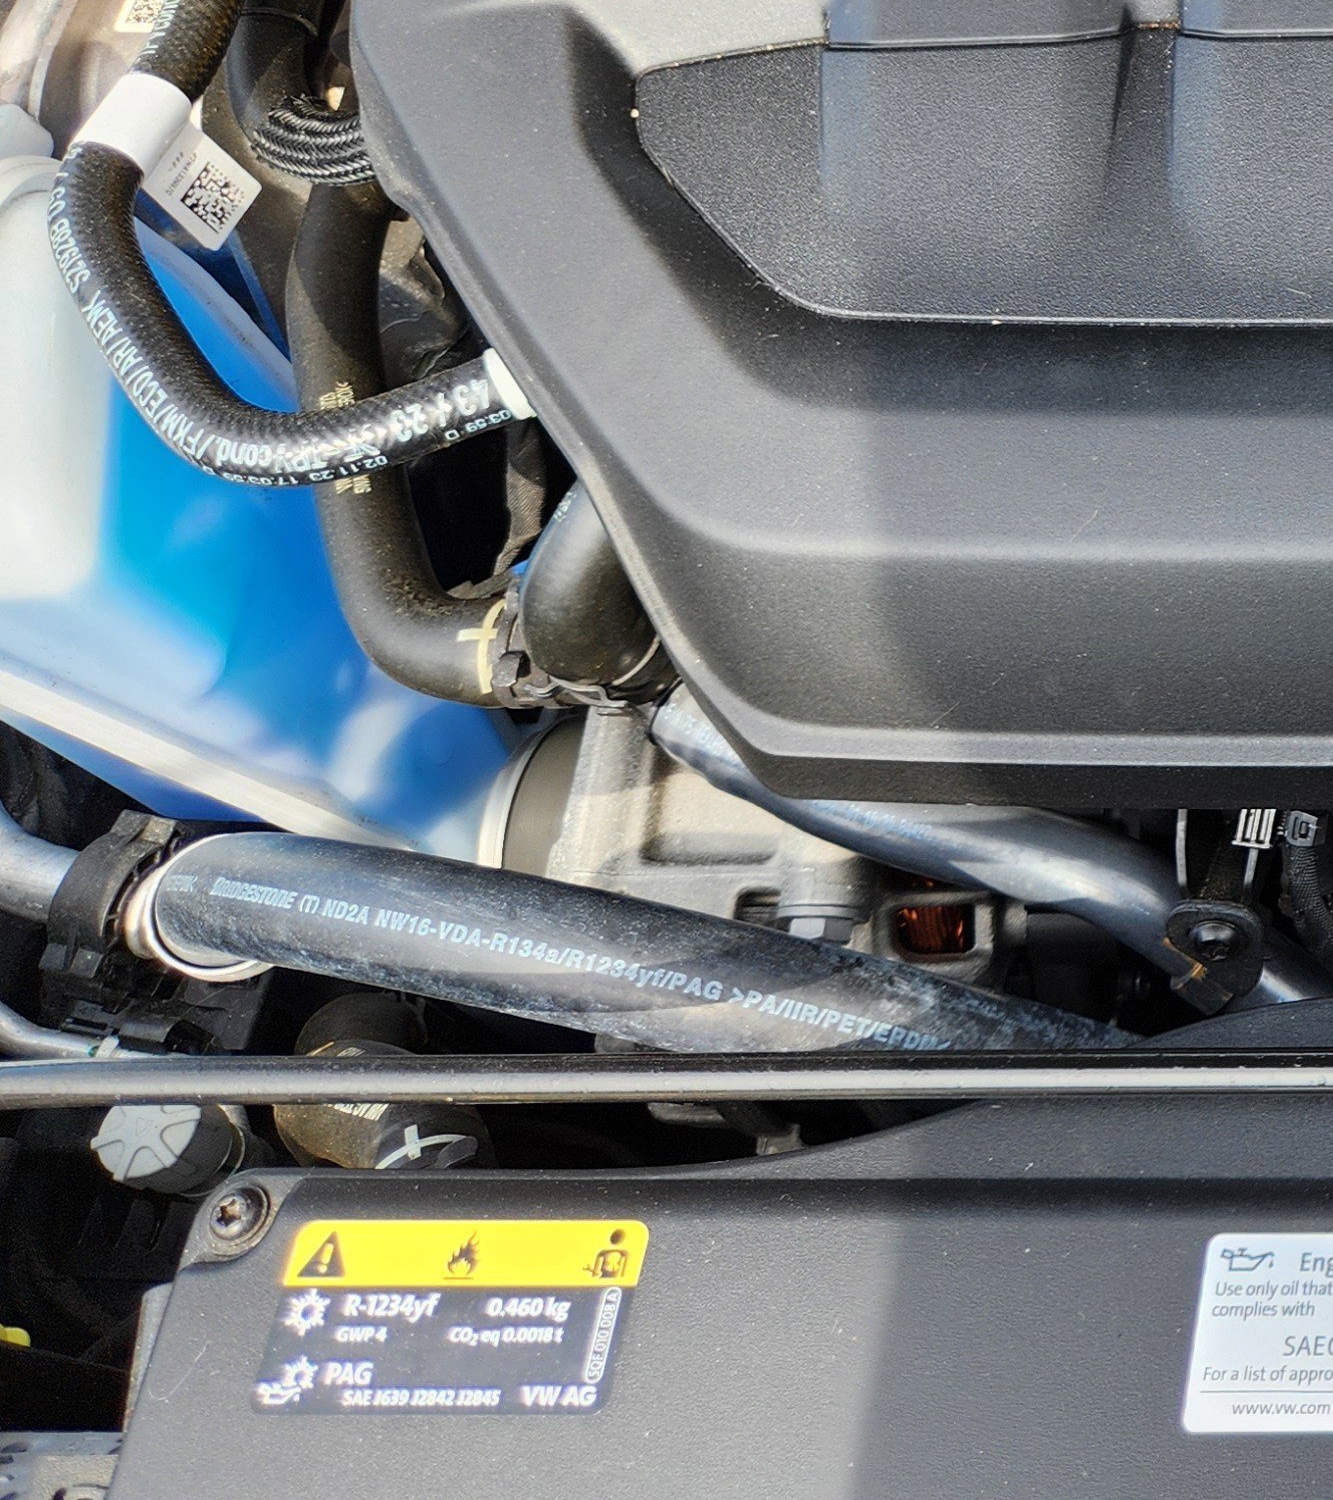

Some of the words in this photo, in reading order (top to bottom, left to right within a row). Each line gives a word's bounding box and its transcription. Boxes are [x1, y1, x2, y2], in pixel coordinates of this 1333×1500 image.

[210, 875, 297, 912] BRIDGESTONE
[321, 901, 369, 928] ND2A
[1215, 1281, 1243, 1296] Use
[1245, 1280, 1279, 1301] only
[1280, 1280, 1299, 1296] oil
[1302, 1280, 1333, 1301] that
[342, 1293, 441, 1324] R-1234yf
[486, 1297, 543, 1318] 0.460
[545, 1296, 571, 1323] kg
[1211, 1300, 1278, 1321] complies
[1281, 1300, 1315, 1316] with
[324, 1361, 374, 1385] PAG
[1202, 1366, 1228, 1381] For
[1230, 1369, 1239, 1381] a
[1243, 1365, 1266, 1382] list
[1269, 1364, 1288, 1381] of
[341, 1388, 372, 1407] SAE
[373, 1389, 410, 1407] J639
[520, 1385, 561, 1407] VW
[562, 1385, 597, 1407] AG
[1232, 1403, 1331, 1415] www.vw.com
